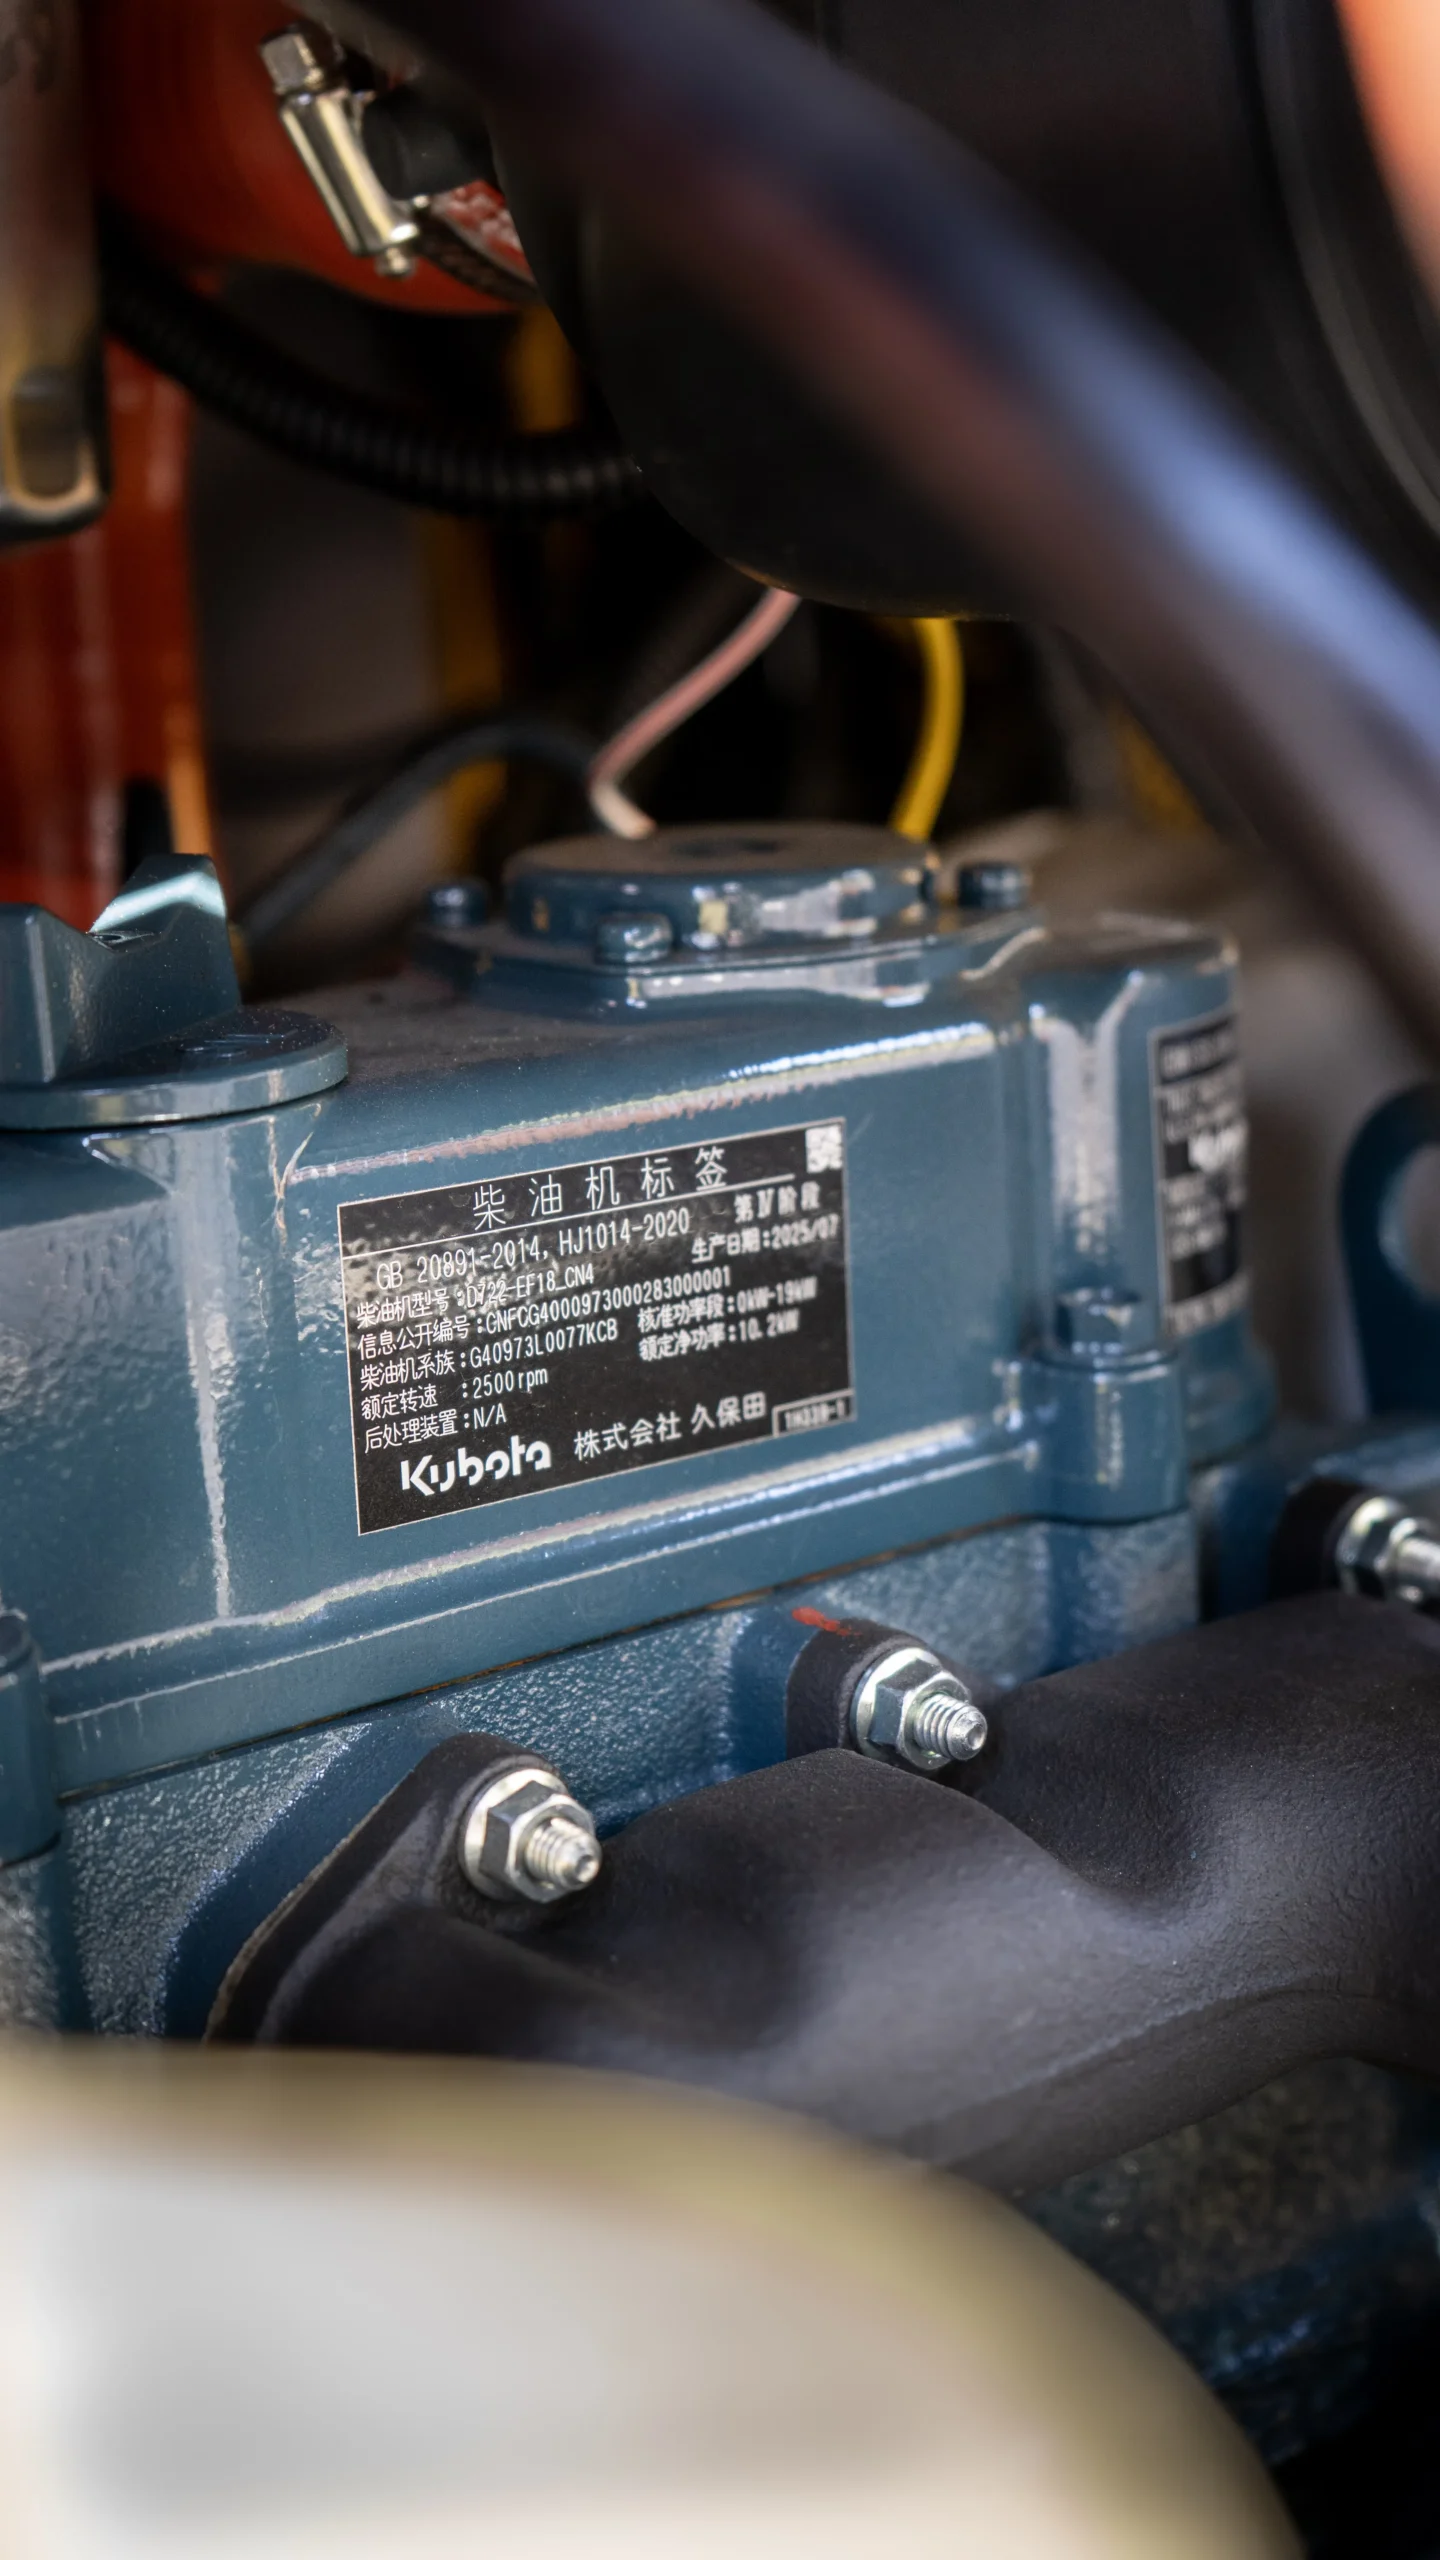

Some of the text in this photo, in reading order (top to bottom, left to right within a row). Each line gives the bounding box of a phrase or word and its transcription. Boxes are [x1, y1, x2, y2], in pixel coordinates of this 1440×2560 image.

[473, 1146, 728, 1231] 柴油机标签
[376, 1207, 690, 1290] GB 20891-2014, HJ1014-2020
[361, 1383, 438, 1420] 额定转速
[574, 1411, 682, 1461] 株式会社
[691, 1391, 767, 1435] 久保田
[400, 1434, 552, 1496] Kubota
